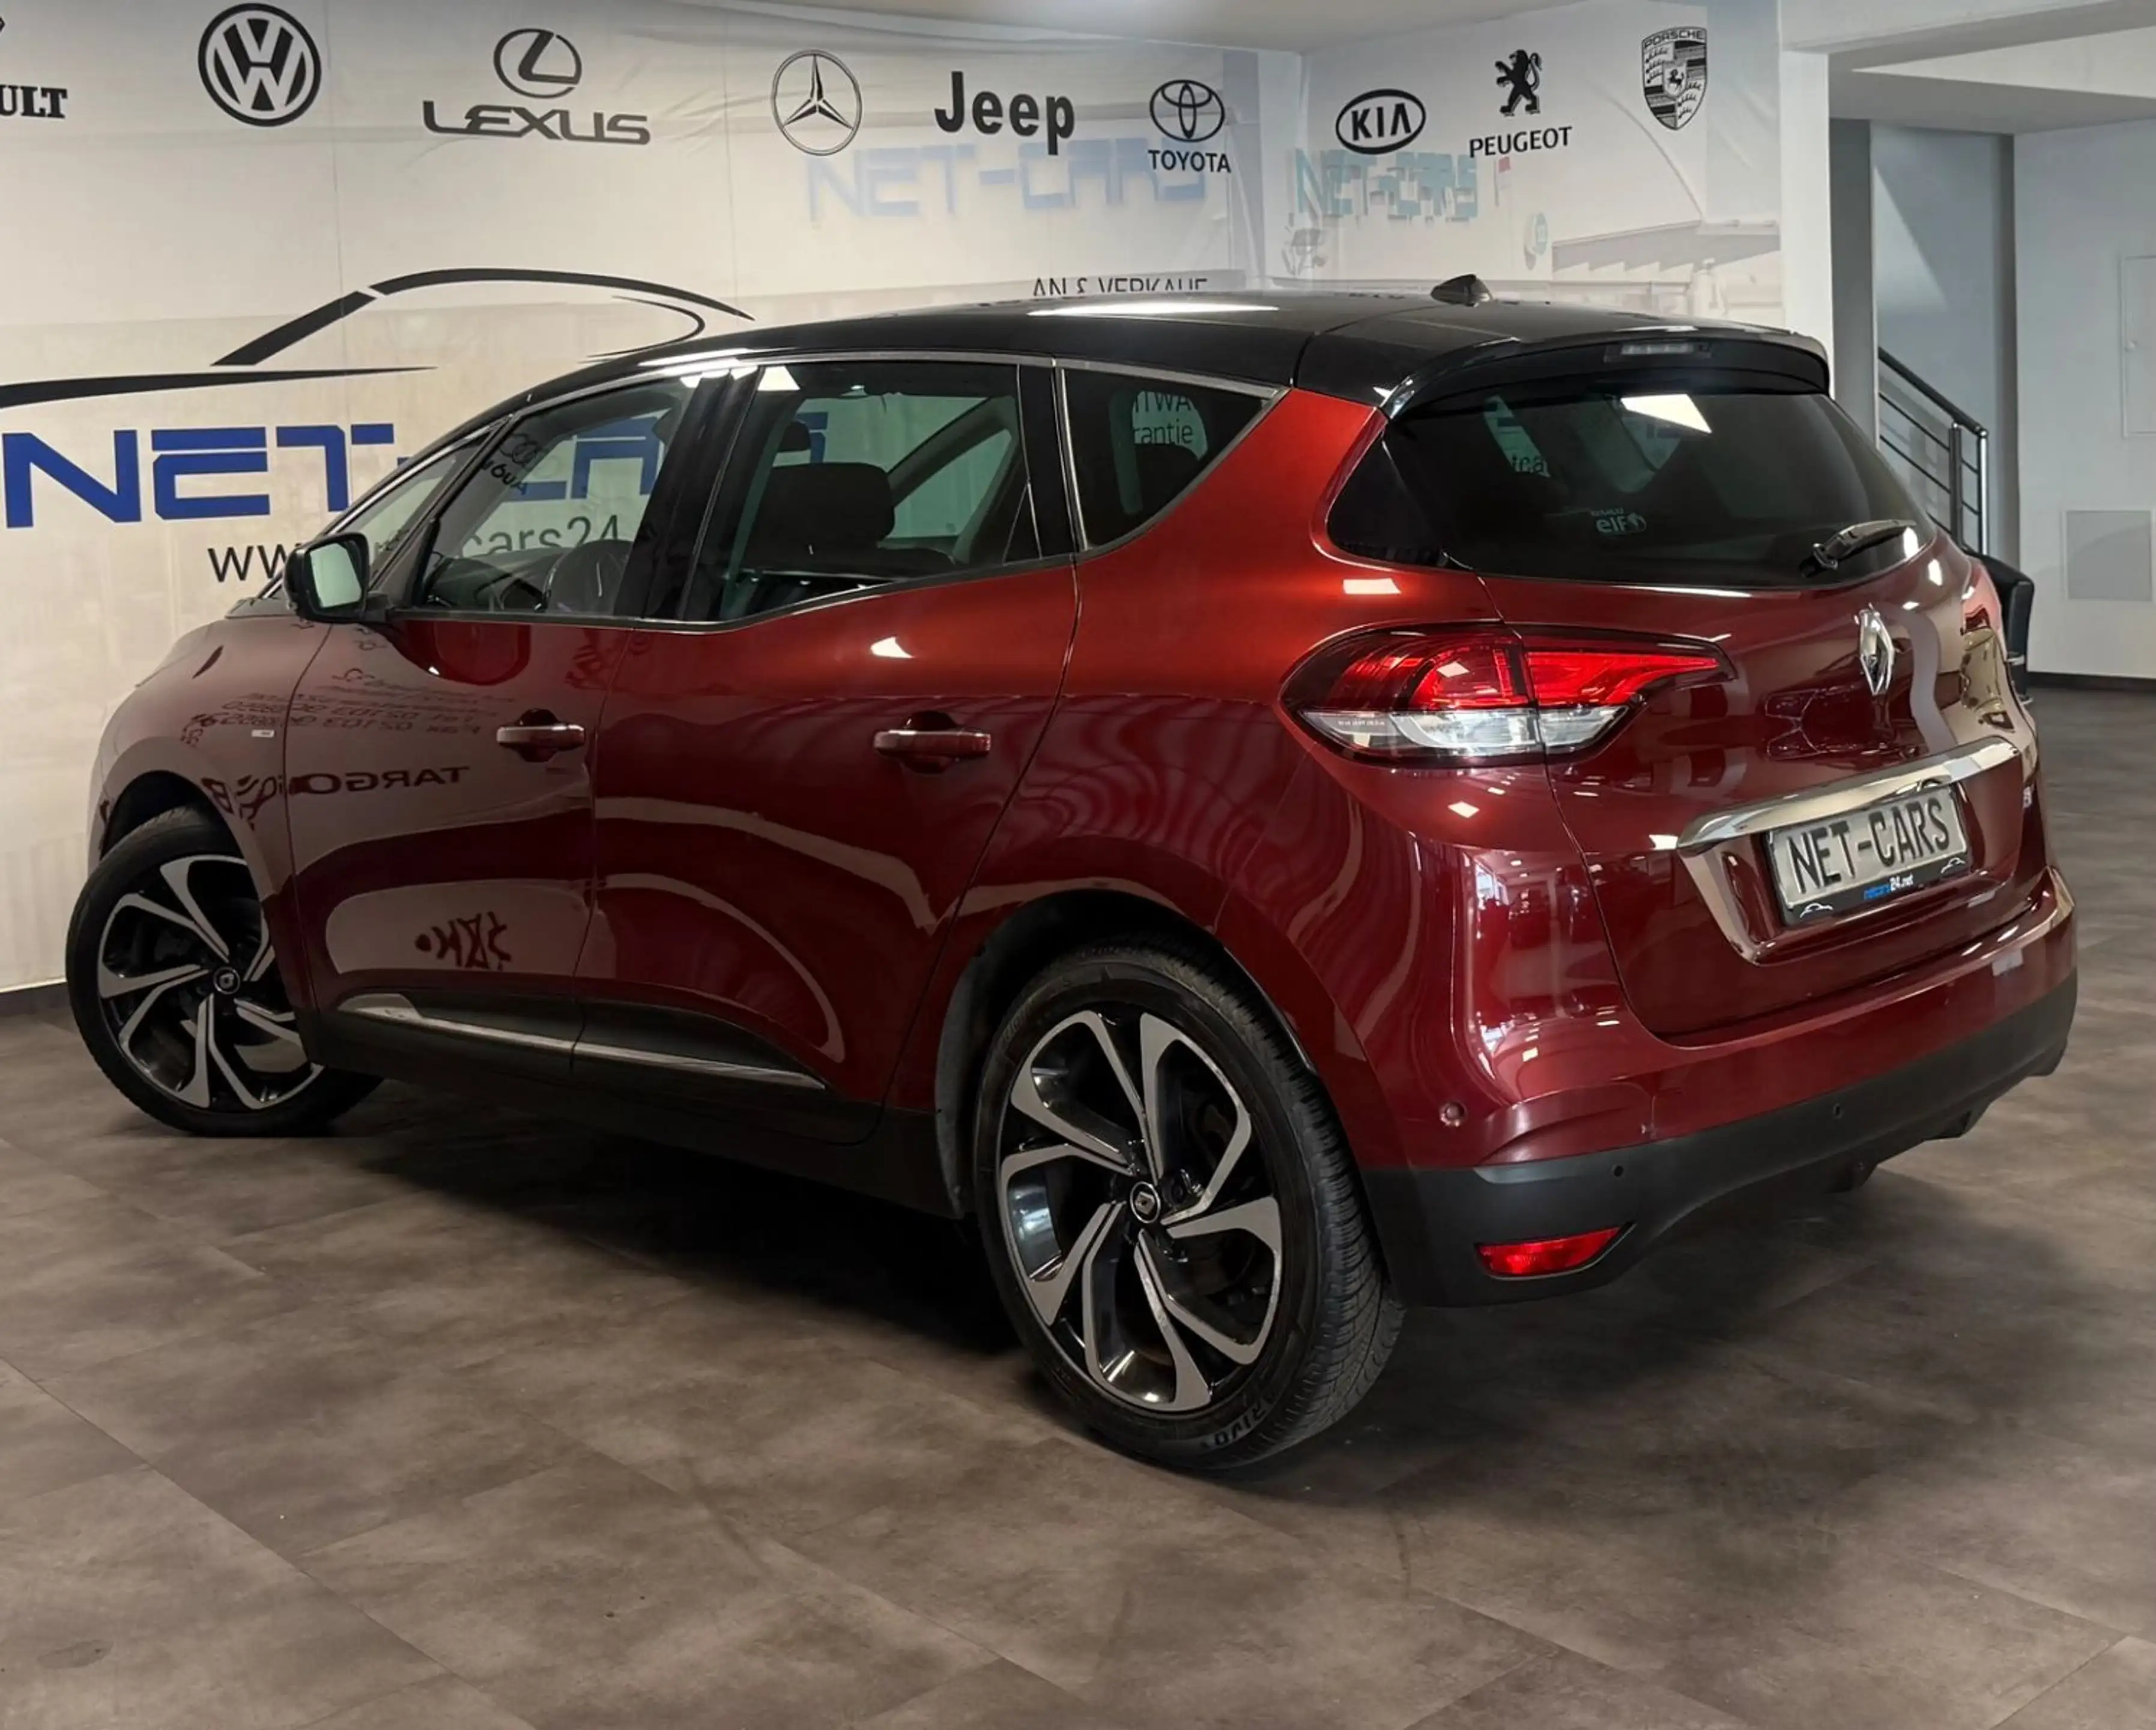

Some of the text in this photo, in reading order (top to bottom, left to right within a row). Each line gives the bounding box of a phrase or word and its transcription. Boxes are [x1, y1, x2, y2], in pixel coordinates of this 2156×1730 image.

[1643, 29, 1706, 49] PORSCHE
[423, 100, 650, 145] LEXUS
[934, 70, 1075, 156] Jeep
[1351, 102, 1413, 142] KIA
[1469, 126, 1573, 158] PEUGEOT
[1148, 148, 1232, 173] TOYOTA
[1596, 515, 1626, 533] elf
[1787, 797, 1949, 894] NET-CARS
